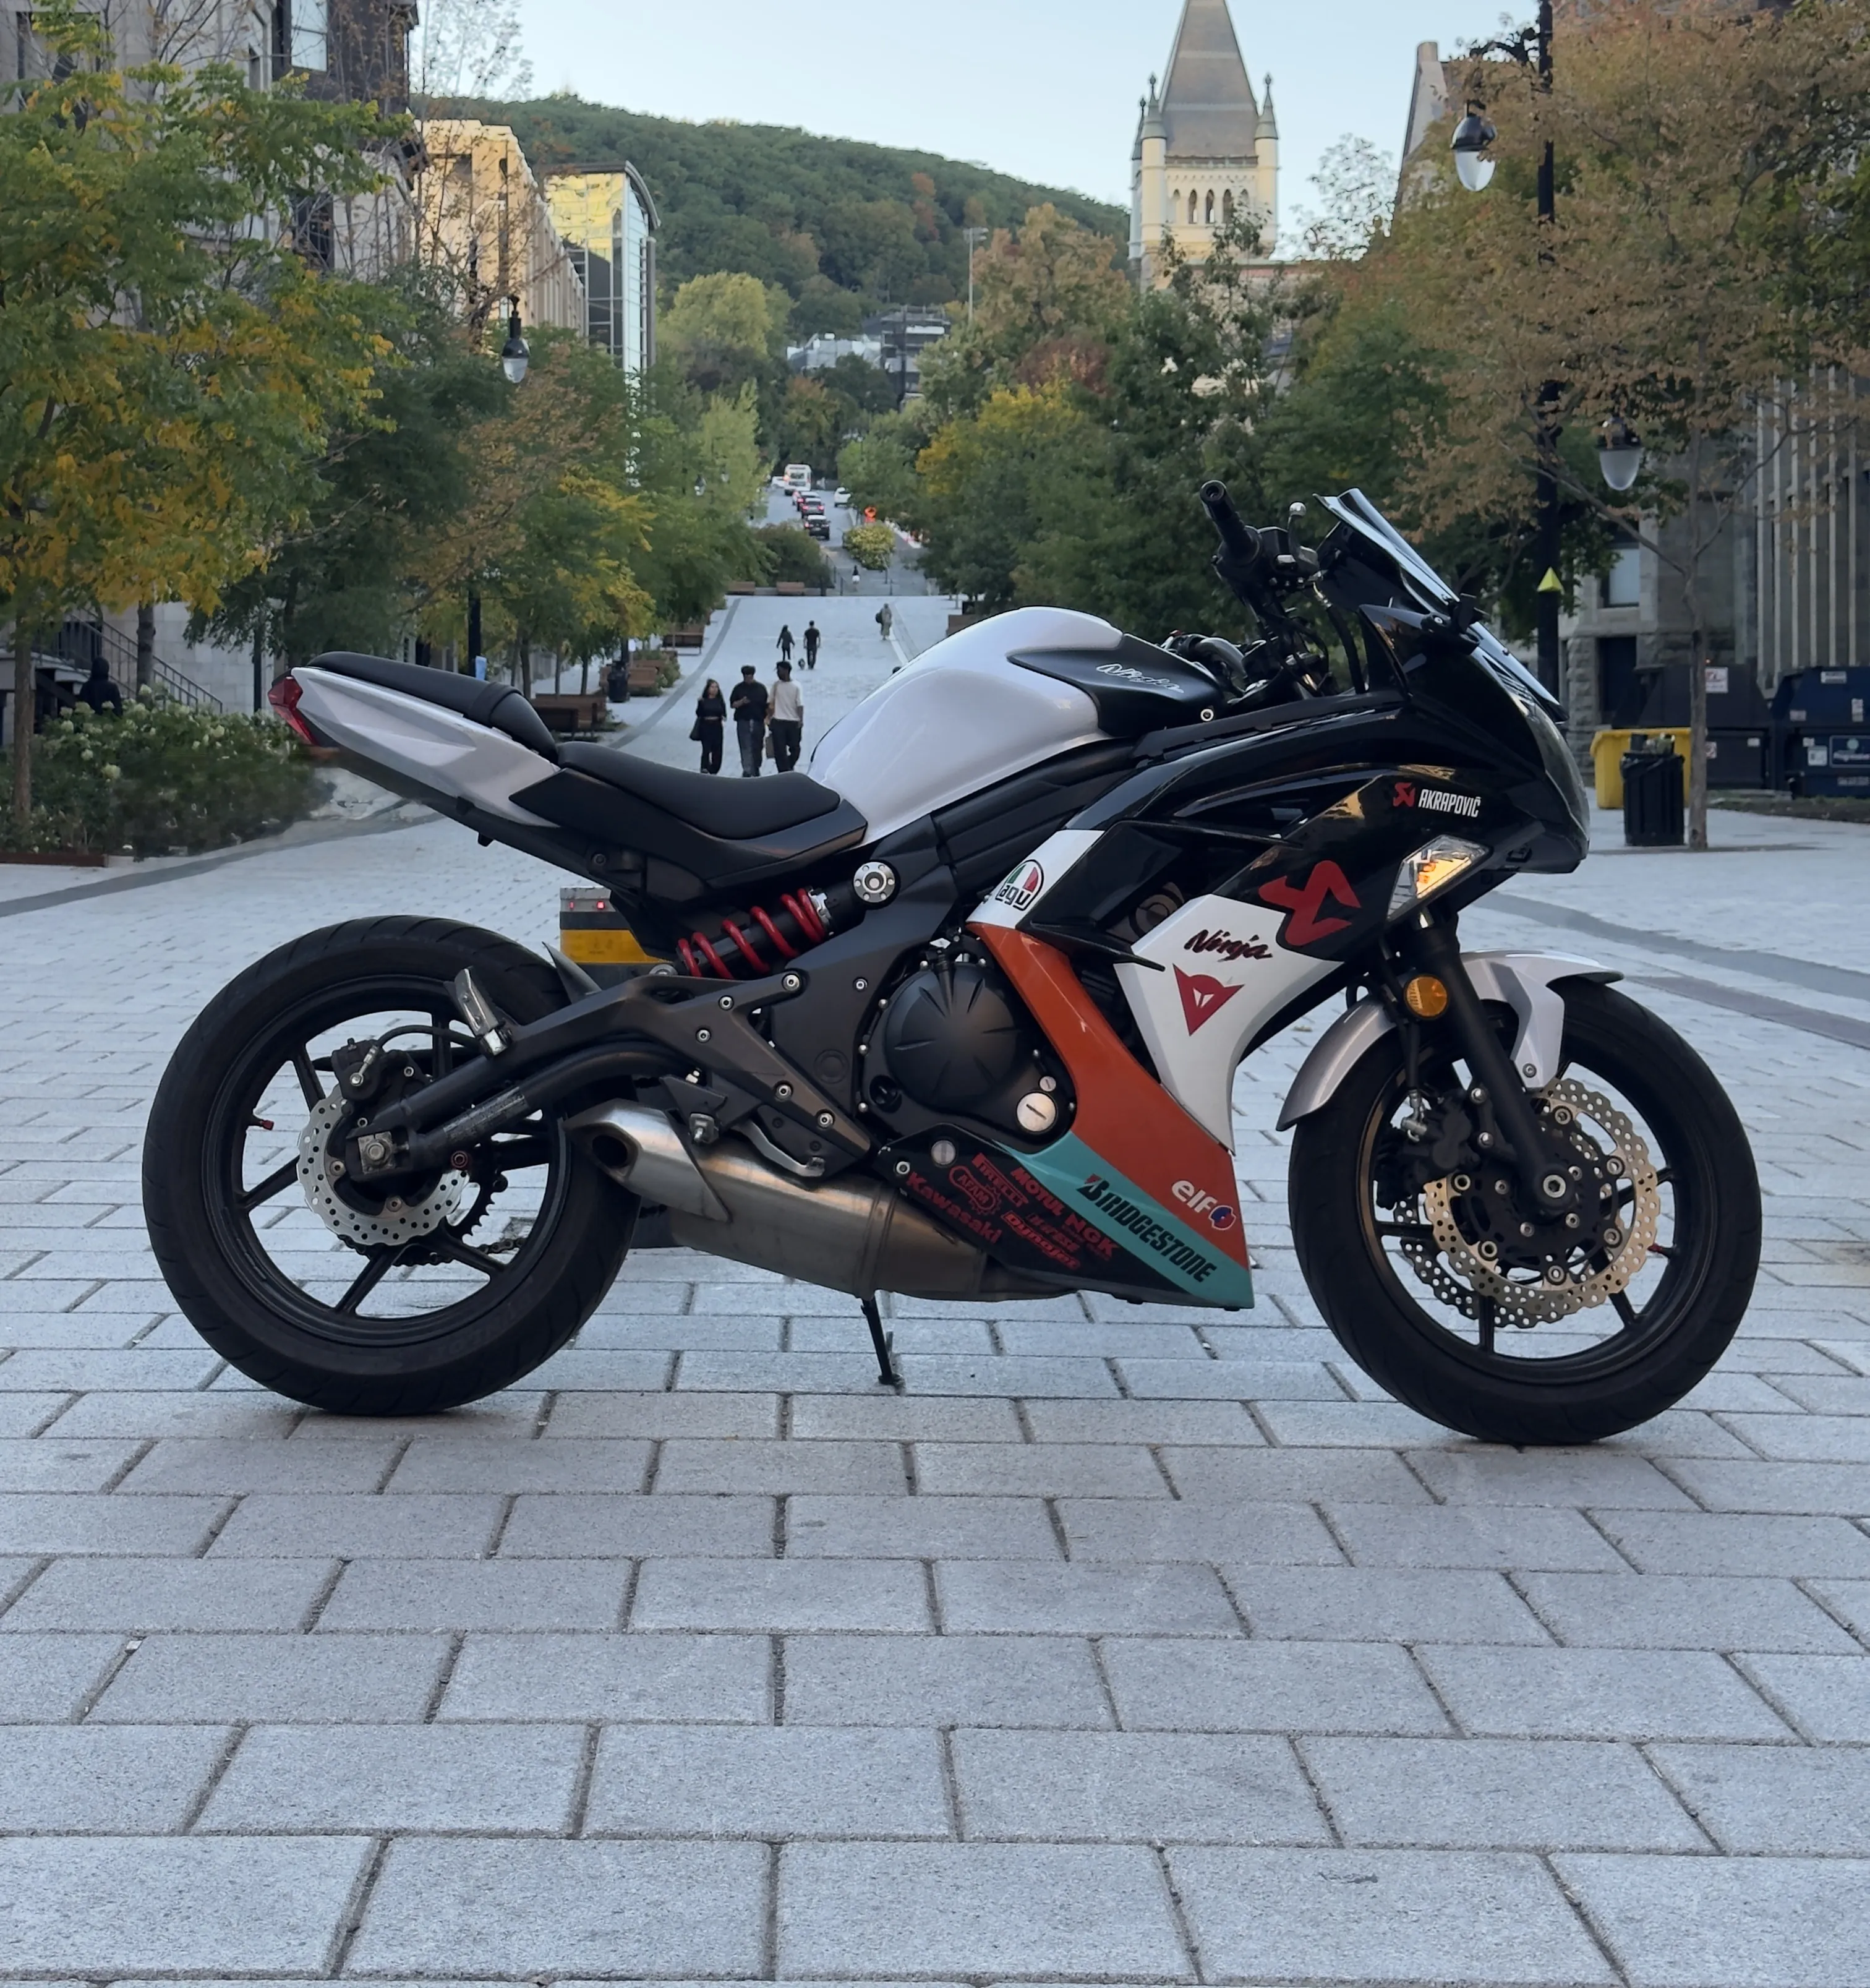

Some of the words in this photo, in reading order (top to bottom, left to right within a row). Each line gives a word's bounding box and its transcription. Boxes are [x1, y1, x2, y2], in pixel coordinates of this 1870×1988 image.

[1418, 789, 1482, 818] AKRAPOVIČ
[1184, 928, 1273, 962] Ninja
[957, 1175, 989, 1204] AFAM
[972, 1152, 1028, 1207] PIRELLI
[1010, 1167, 1065, 1216] MOTUL
[1172, 1180, 1218, 1213] elf
[906, 1172, 1002, 1243] Kawasaki
[1076, 1173, 1217, 1283] BRIDGESTONE
[1064, 1212, 1119, 1258] NGK
